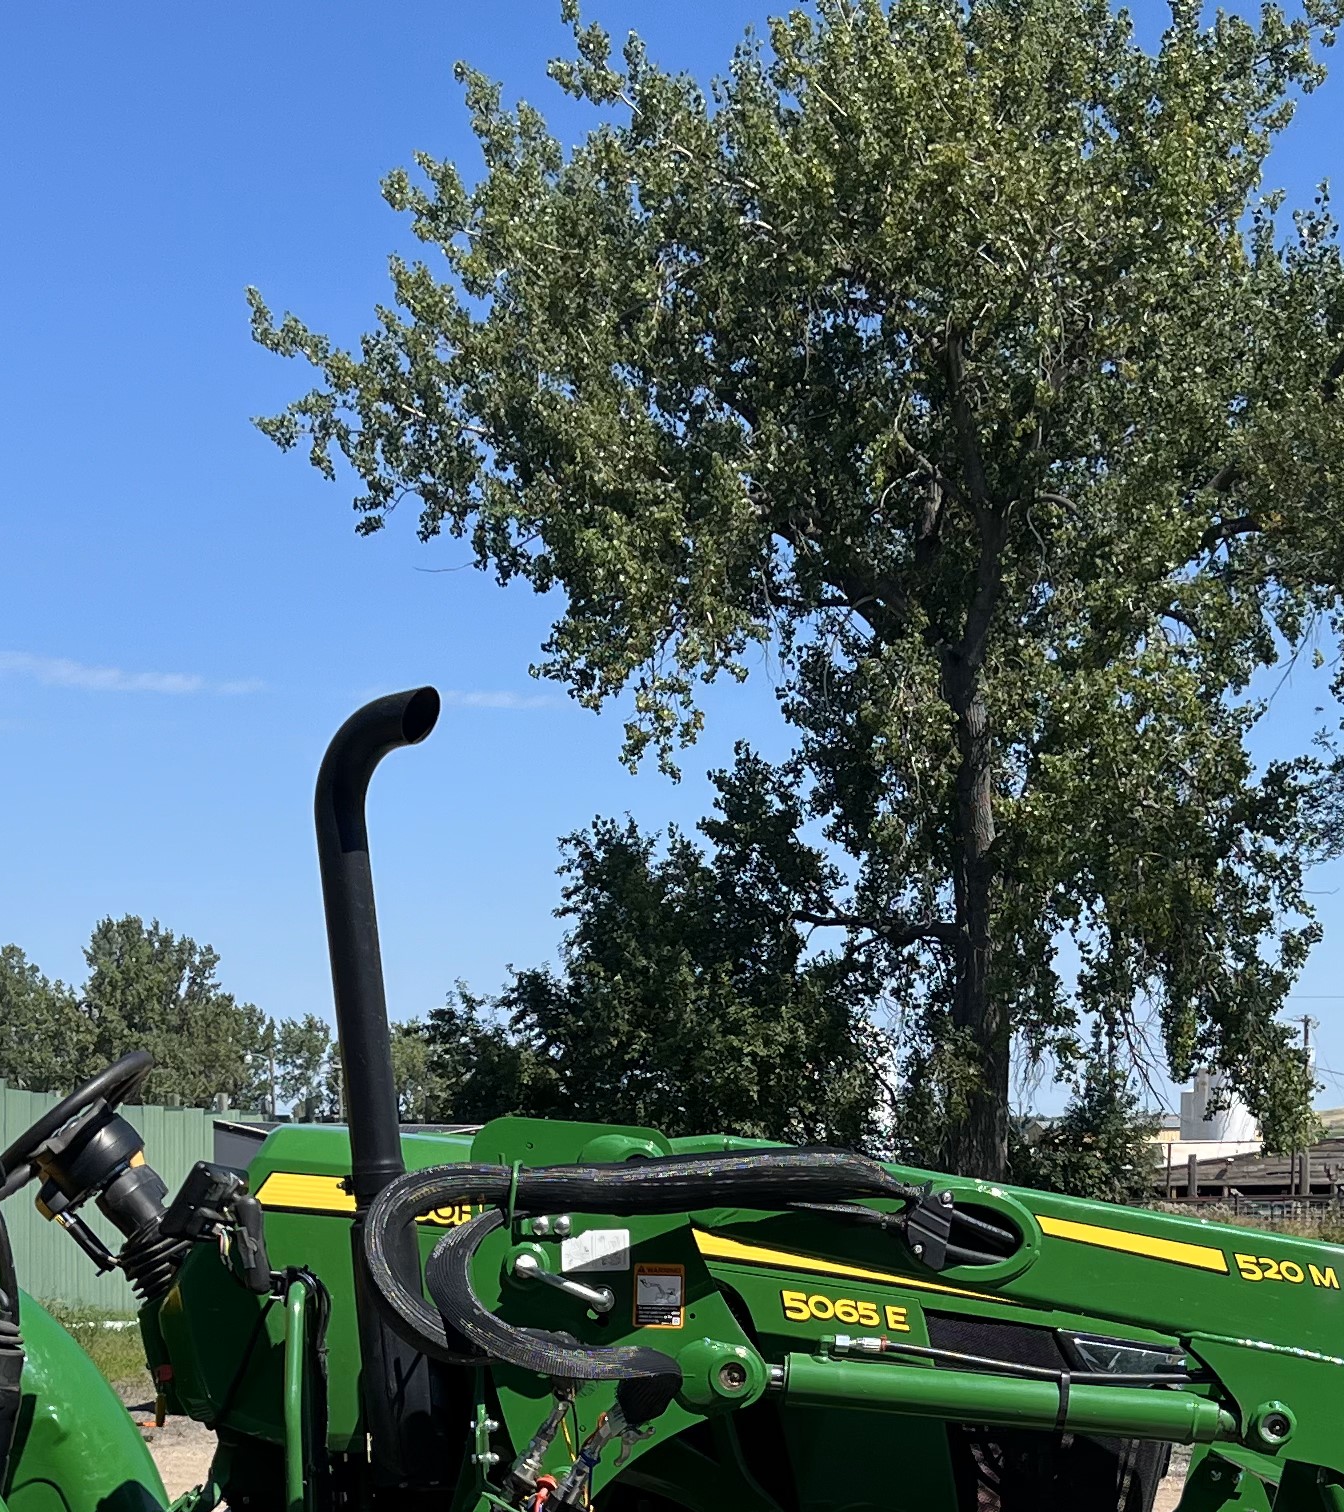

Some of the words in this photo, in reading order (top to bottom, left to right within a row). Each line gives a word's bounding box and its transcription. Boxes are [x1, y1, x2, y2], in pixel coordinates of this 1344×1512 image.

[1234, 1253, 1304, 1283] 520
[1307, 1263, 1341, 1290] M
[781, 1290, 881, 1327] 5065
[885, 1304, 911, 1331] E
